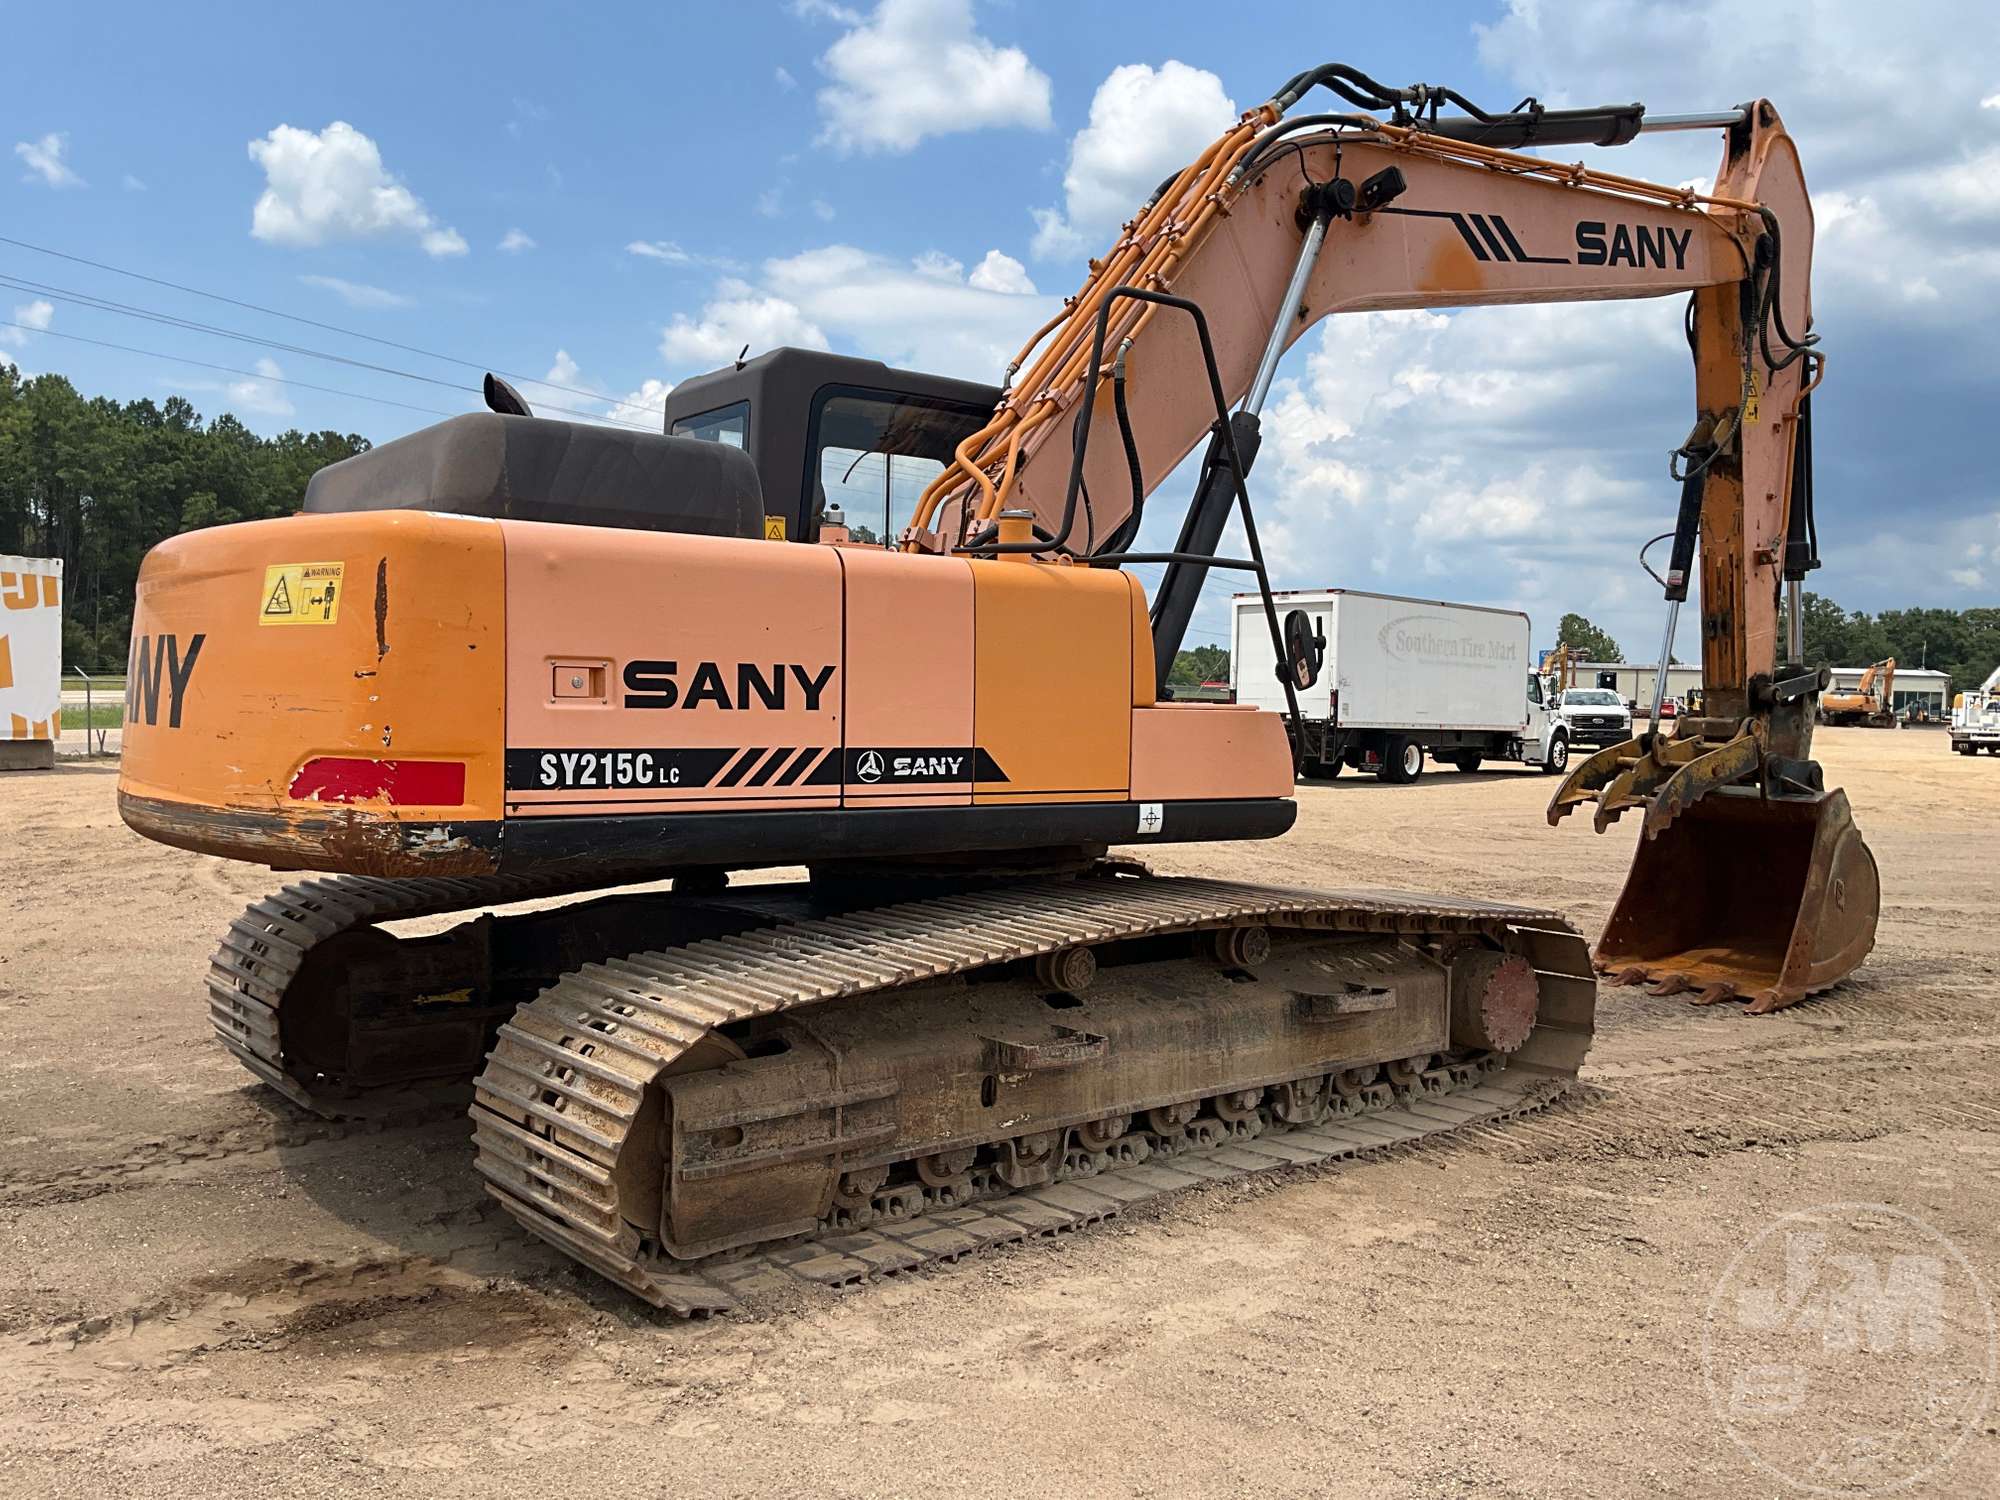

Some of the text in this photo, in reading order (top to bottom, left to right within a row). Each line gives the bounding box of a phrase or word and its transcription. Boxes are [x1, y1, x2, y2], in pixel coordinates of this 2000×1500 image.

[1575, 220, 1693, 270] SANY
[311, 567, 342, 577] WARNING
[1395, 629, 1517, 661] Southern Tire Mart
[622, 660, 837, 711] SANY
[540, 752, 680, 785] SY215C LC
[893, 756, 964, 776] SANY
